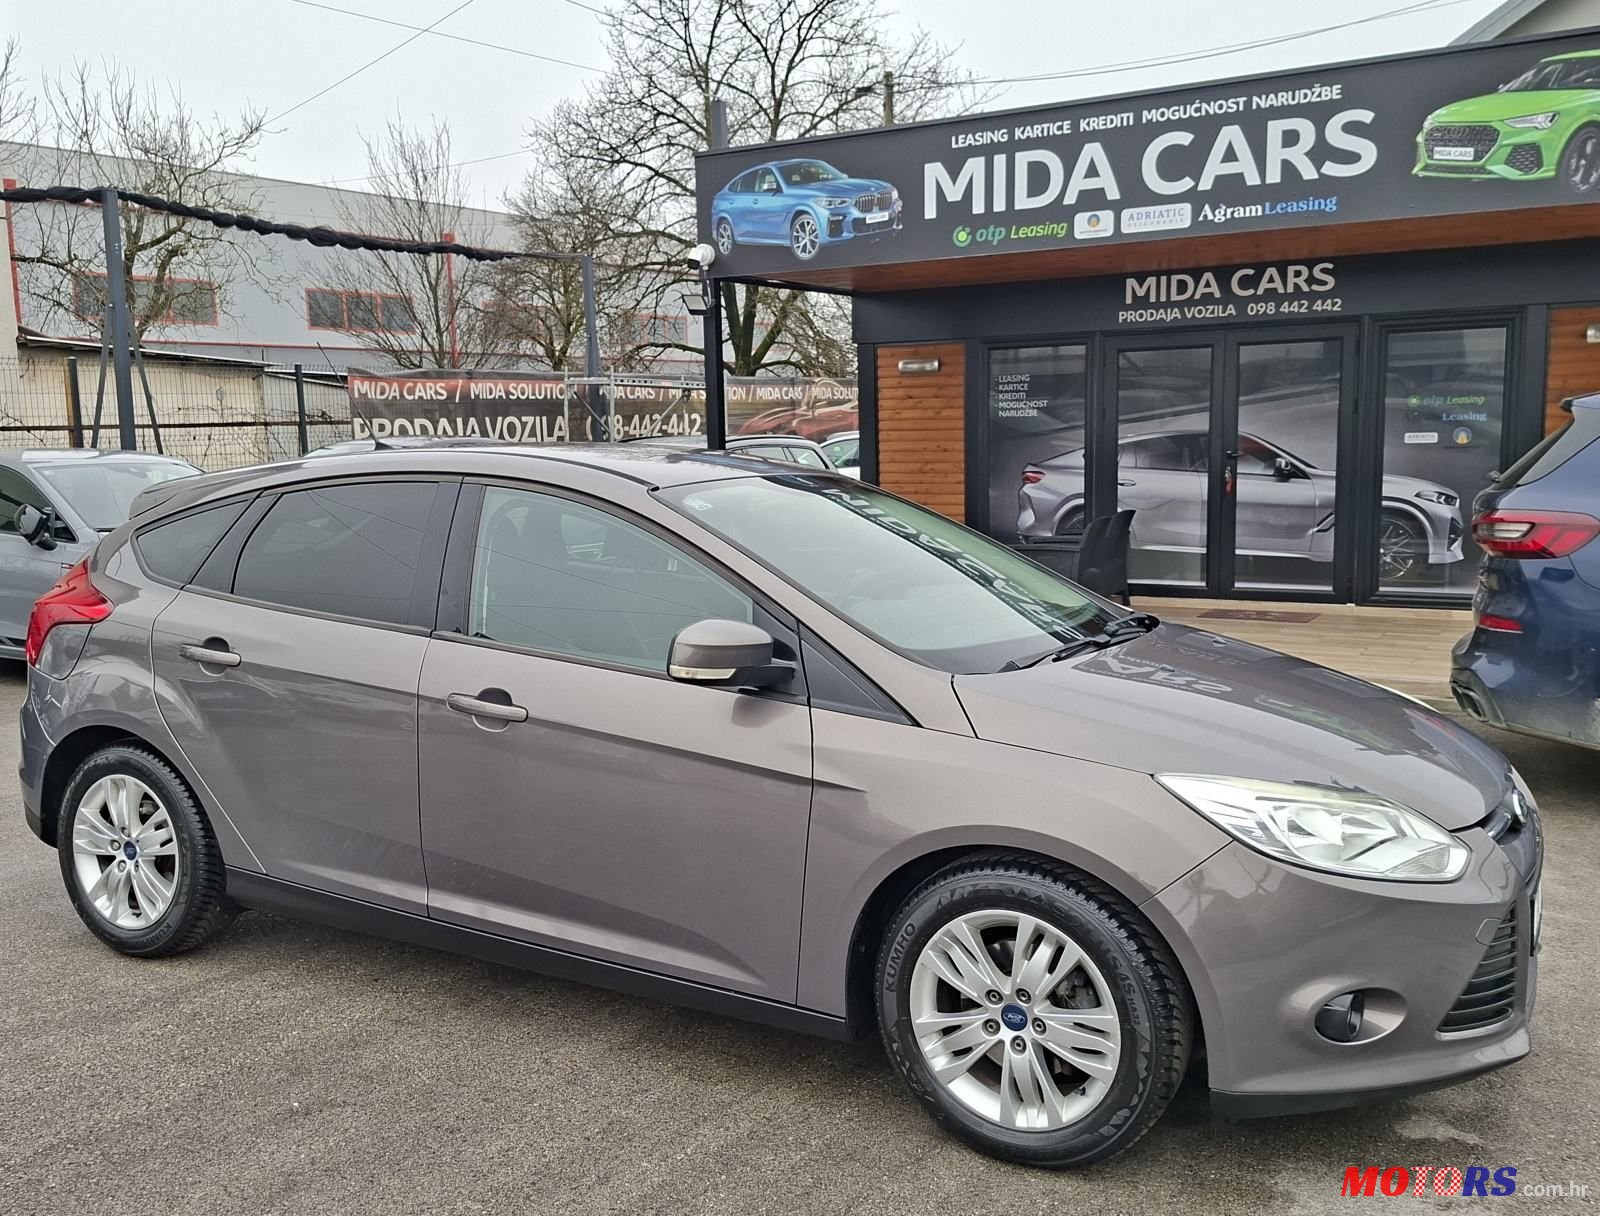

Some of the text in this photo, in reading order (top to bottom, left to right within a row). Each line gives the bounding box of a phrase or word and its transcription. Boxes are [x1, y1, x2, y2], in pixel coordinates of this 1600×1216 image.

[951, 83, 1342, 148] LEASING KARTICE KREDITI MOGUĆNOST NARUDŽBE
[923, 108, 1378, 220] MIDA CARS
[1127, 208, 1185, 222] ADRIATIC
[975, 221, 1068, 246] otp Leasing
[1125, 262, 1335, 304] MIDA CARS
[1118, 298, 1342, 323] PRODAJA VOZILA 098 442 442
[998, 374, 1031, 383] LEASING
[998, 383, 1029, 391] KARTICE
[353, 380, 400, 400] MIDA
[403, 382, 447, 400] CARS
[470, 382, 505, 399] MIDA
[627, 387, 655, 399] CARS
[757, 387, 780, 400] MIDA
[998, 392, 1026, 400] KREDITI
[1446, 395, 1485, 405] Leasing
[1442, 411, 1487, 421] Leasing
[485, 415, 569, 442] VOZILA
[885, 922, 916, 992] KUMHO
